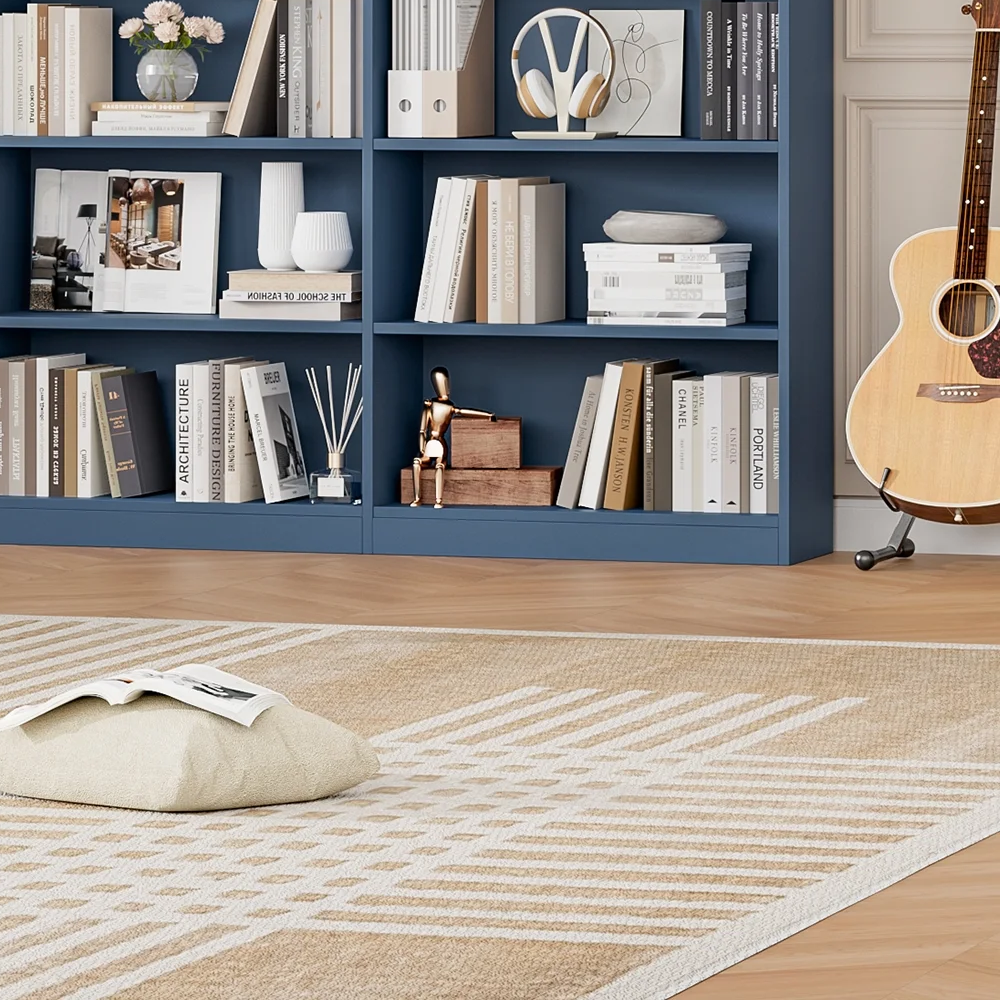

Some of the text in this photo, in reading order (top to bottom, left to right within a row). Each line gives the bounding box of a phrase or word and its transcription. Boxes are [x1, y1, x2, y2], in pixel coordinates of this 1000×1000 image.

[293, 6, 301, 44] STEPHEN
[292, 46, 303, 78] KING
[706, 11, 714, 97] COUNTDOWN TO MECCA
[179, 378, 189, 483] ARCHITECTURE
[211, 363, 220, 501] FURNITURE DESIGN
[228, 396, 236, 472] BRINGING THE HOUSE HOME
[621, 388, 634, 431] KONSTEN
[678, 388, 687, 430] CHANEL
[254, 413, 268, 462] MARCEL BREUER
[752, 428, 764, 490] PORTLAND
